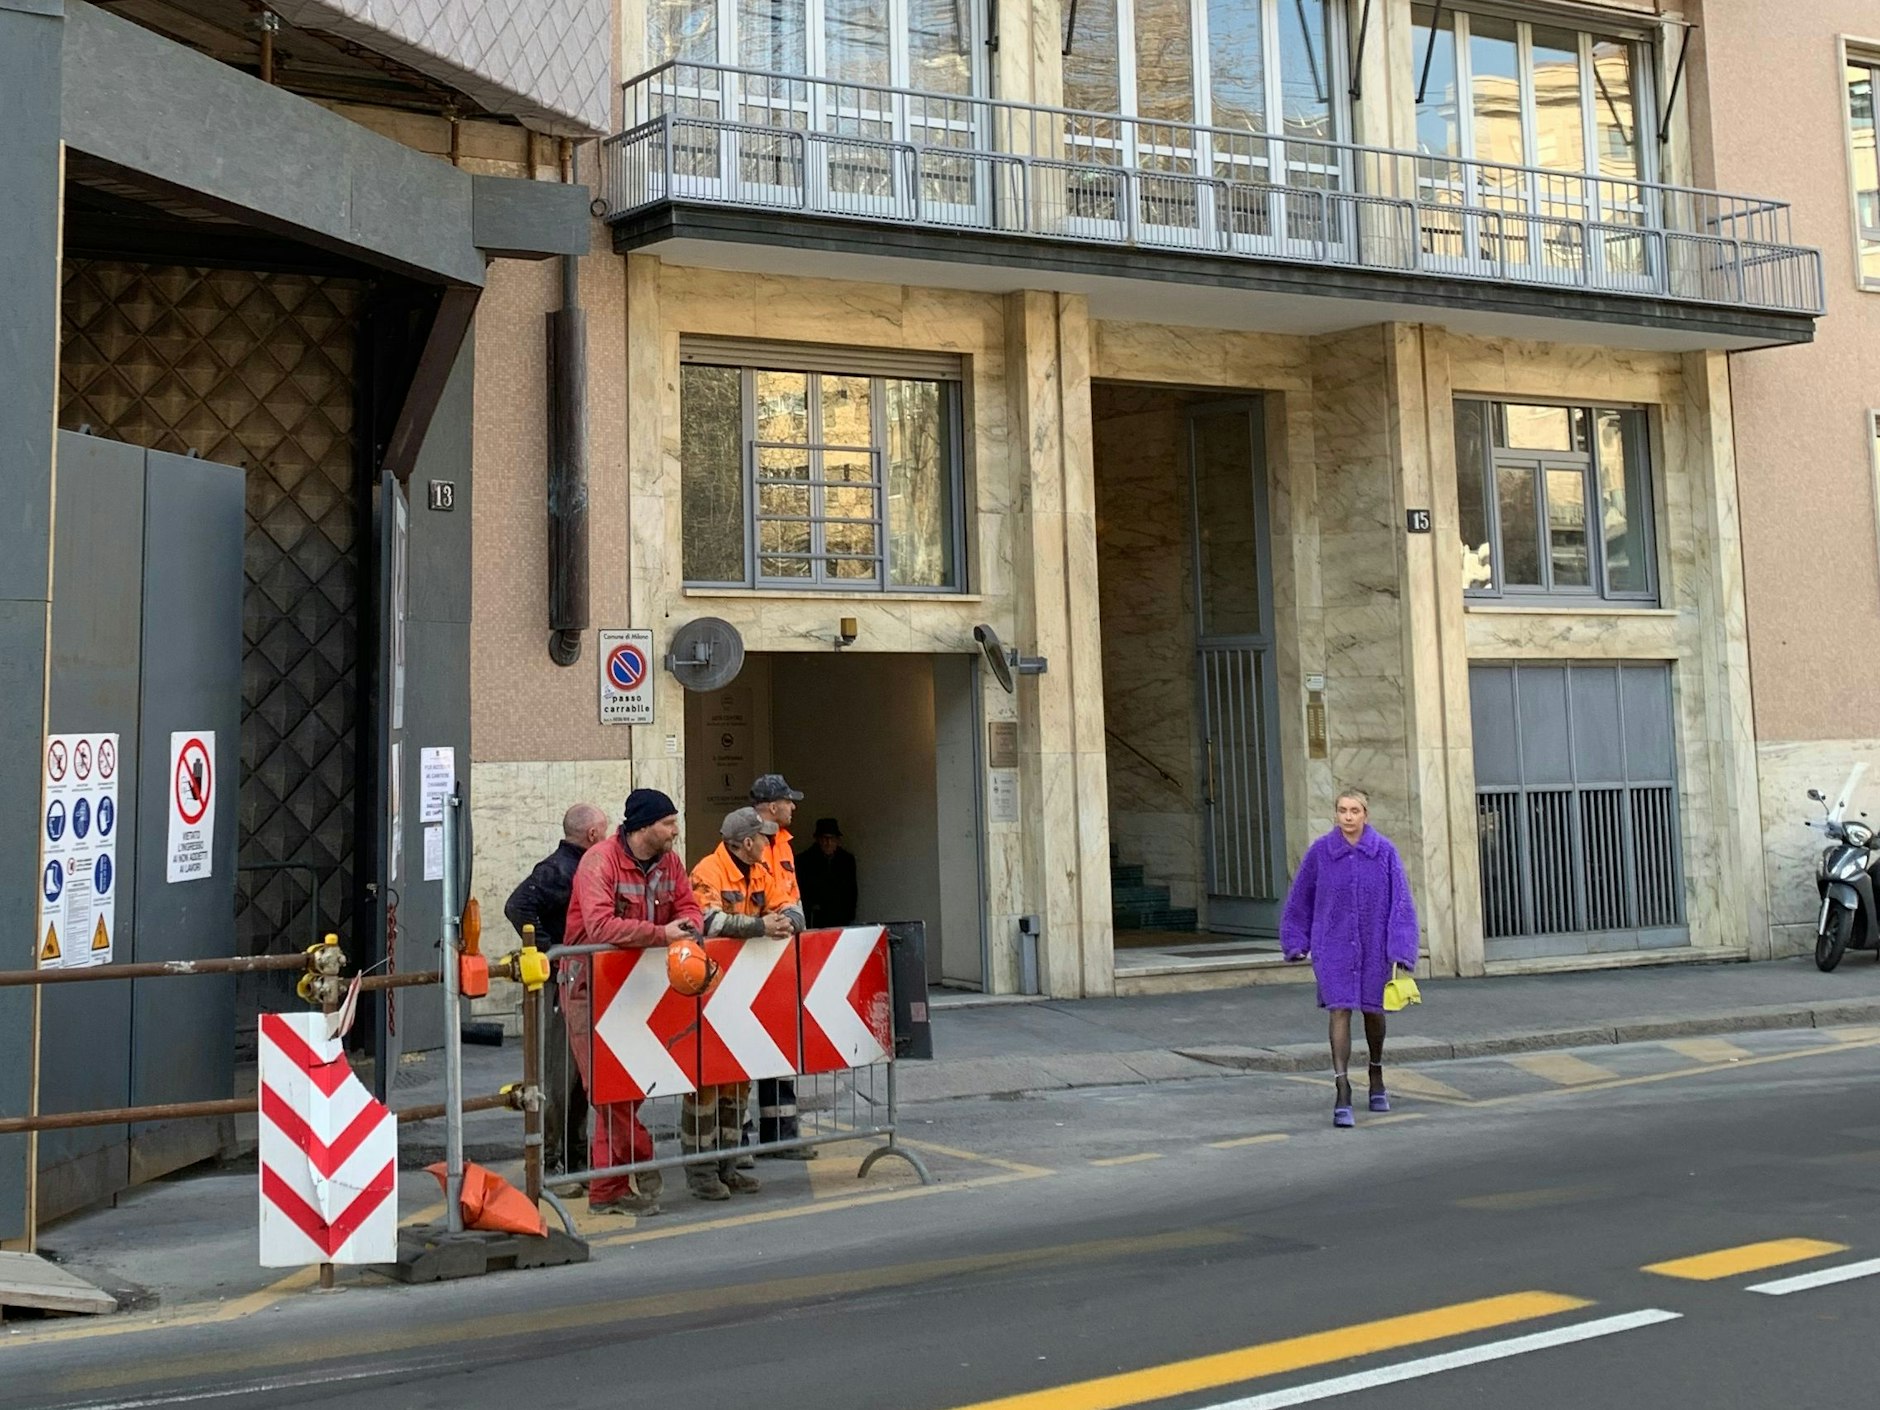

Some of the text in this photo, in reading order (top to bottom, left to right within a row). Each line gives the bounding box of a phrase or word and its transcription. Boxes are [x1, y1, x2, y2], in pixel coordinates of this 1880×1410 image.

[435, 485, 452, 507] 13
[1413, 512, 1429, 529] 15
[612, 695, 642, 704] passo
[604, 704, 650, 713] carrabile
[183, 831, 201, 840] VIETATO
[179, 854, 189, 862] NON
